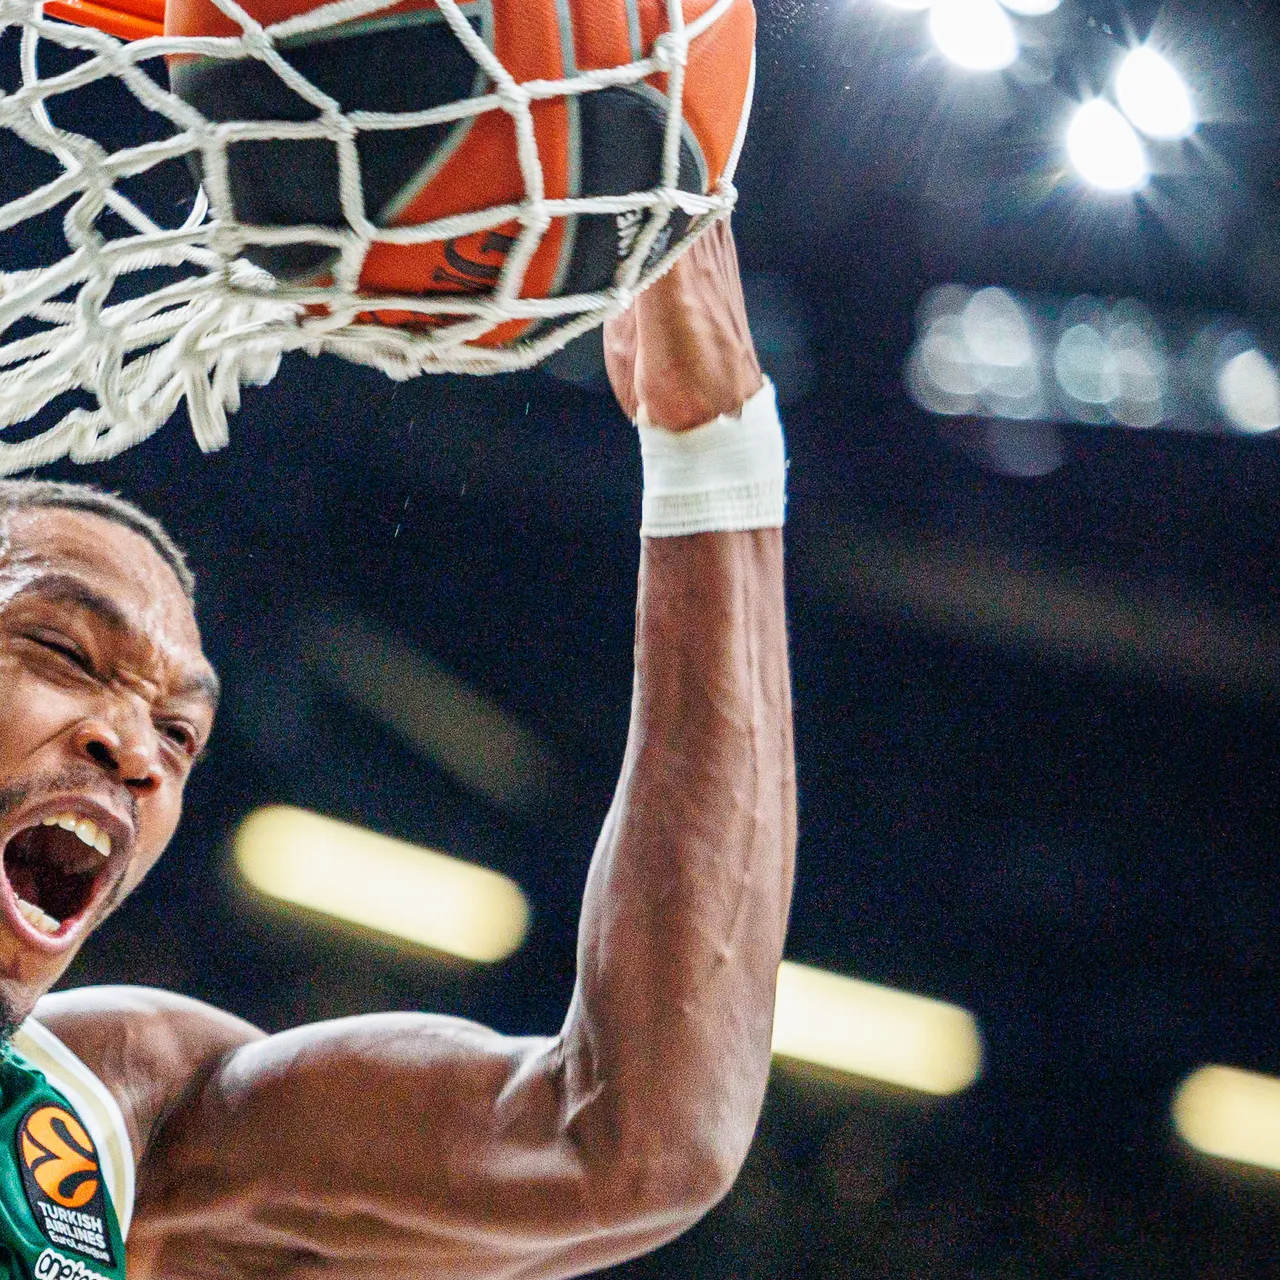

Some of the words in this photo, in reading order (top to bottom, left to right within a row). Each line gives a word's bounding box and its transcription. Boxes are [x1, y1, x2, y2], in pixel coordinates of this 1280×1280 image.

[37, 1201, 103, 1233] TURKISH
[45, 1218, 107, 1250] AIRLINES
[48, 1231, 111, 1262] EuroLeague
